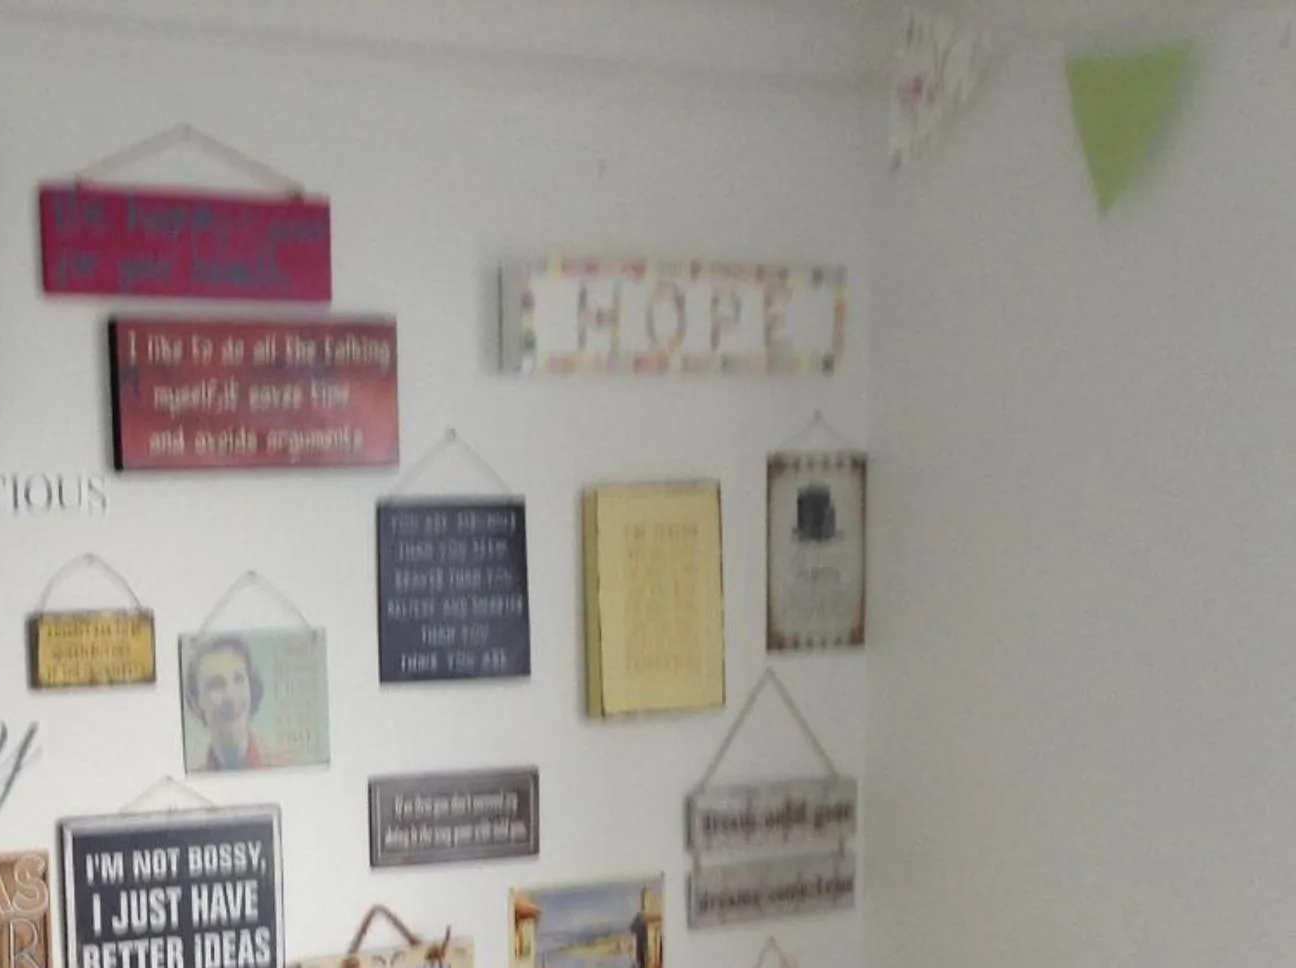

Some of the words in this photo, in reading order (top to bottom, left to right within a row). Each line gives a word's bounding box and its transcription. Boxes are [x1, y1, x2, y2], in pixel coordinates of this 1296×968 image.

[147, 333, 182, 366] like
[191, 333, 212, 366] to
[222, 335, 244, 366] do
[254, 334, 276, 366] all
[285, 332, 315, 367] the
[324, 332, 391, 371] talking
[148, 427, 184, 457] and
[86, 852, 124, 885] I'M
[132, 848, 180, 881] NOT
[188, 840, 266, 877] BOSSY,
[92, 891, 102, 937] I
[111, 885, 183, 936] JUST
[190, 879, 260, 927] HAVE
